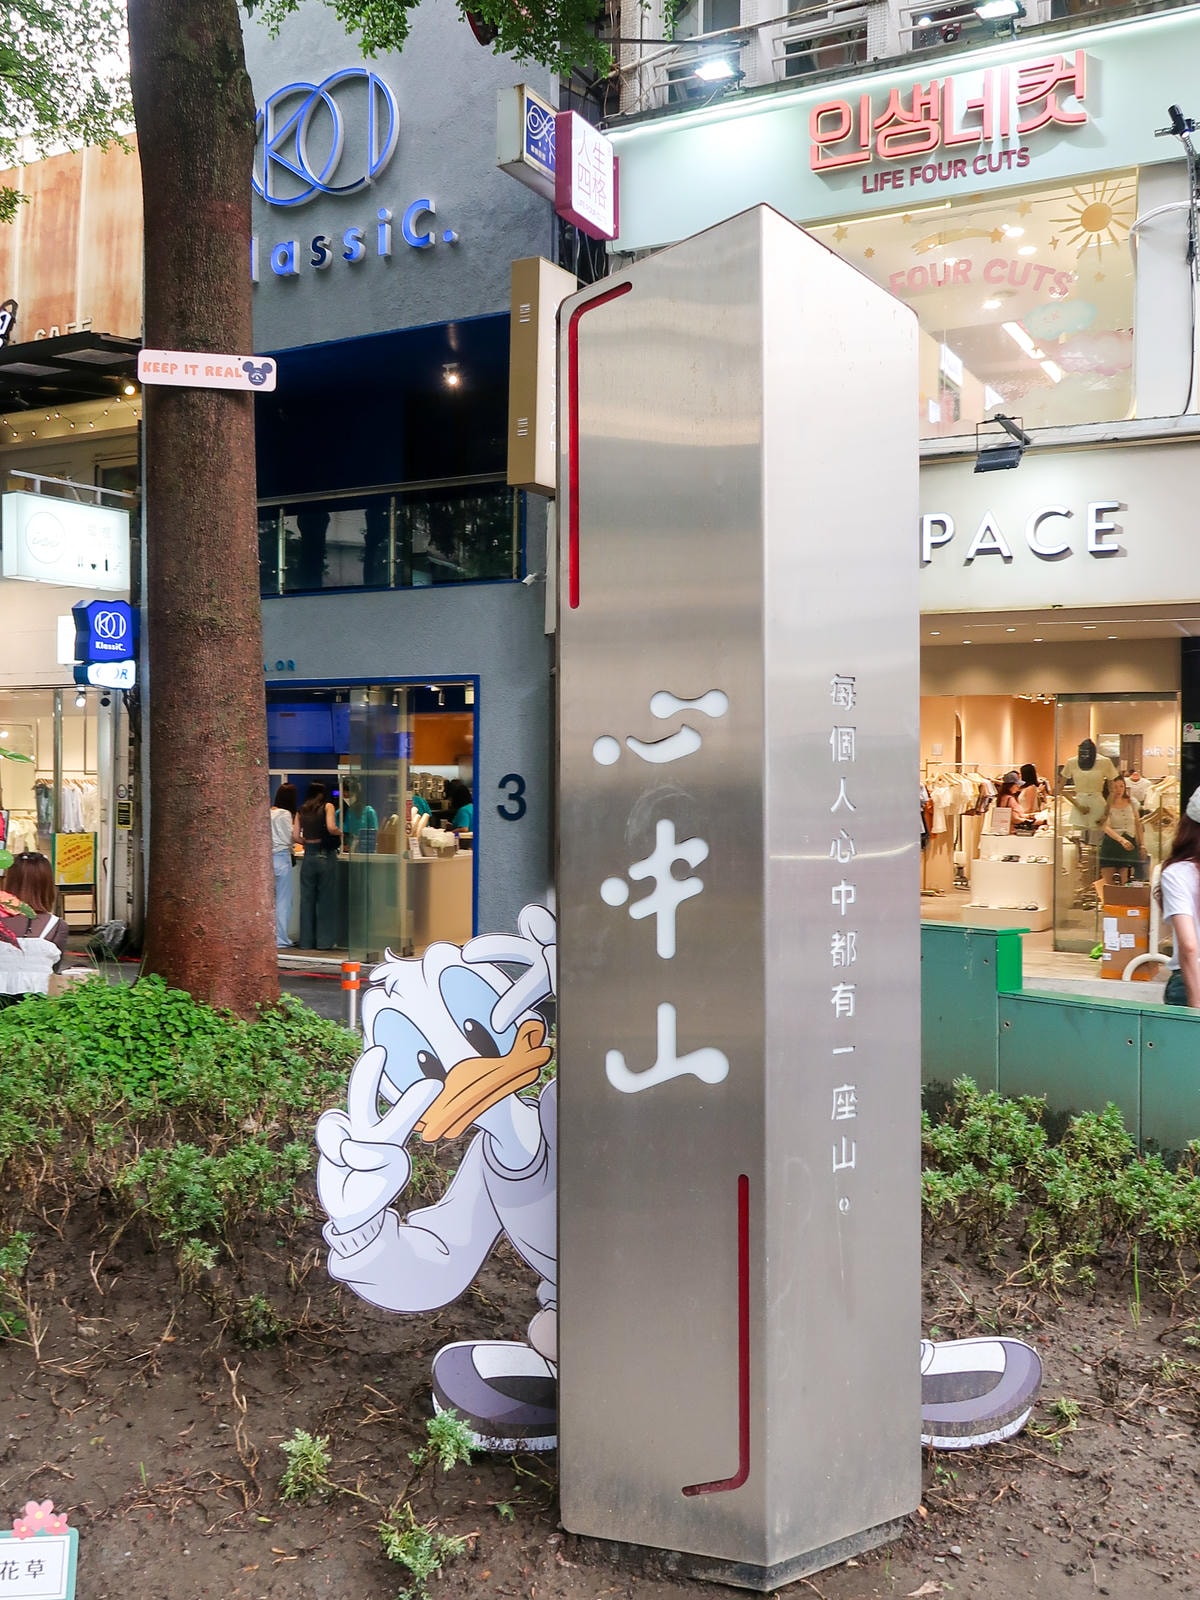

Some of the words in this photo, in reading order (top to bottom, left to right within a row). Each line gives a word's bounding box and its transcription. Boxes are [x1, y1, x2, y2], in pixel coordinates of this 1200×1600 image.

[809, 49, 1087, 172] 인생네컷
[578, 130, 607, 177] 人生
[862, 169, 904, 194] LIFE
[910, 158, 967, 189] FOUR
[973, 147, 1030, 175] CUTS
[889, 259, 973, 297] FOUR
[983, 258, 1073, 297] CUTS
[143, 361, 179, 375] KEEP
[184, 364, 199, 376] IT
[205, 365, 243, 378] REAL
[497, 773, 527, 822] 3
[829, 673, 858, 1216] 每個人心中都有一座山。
